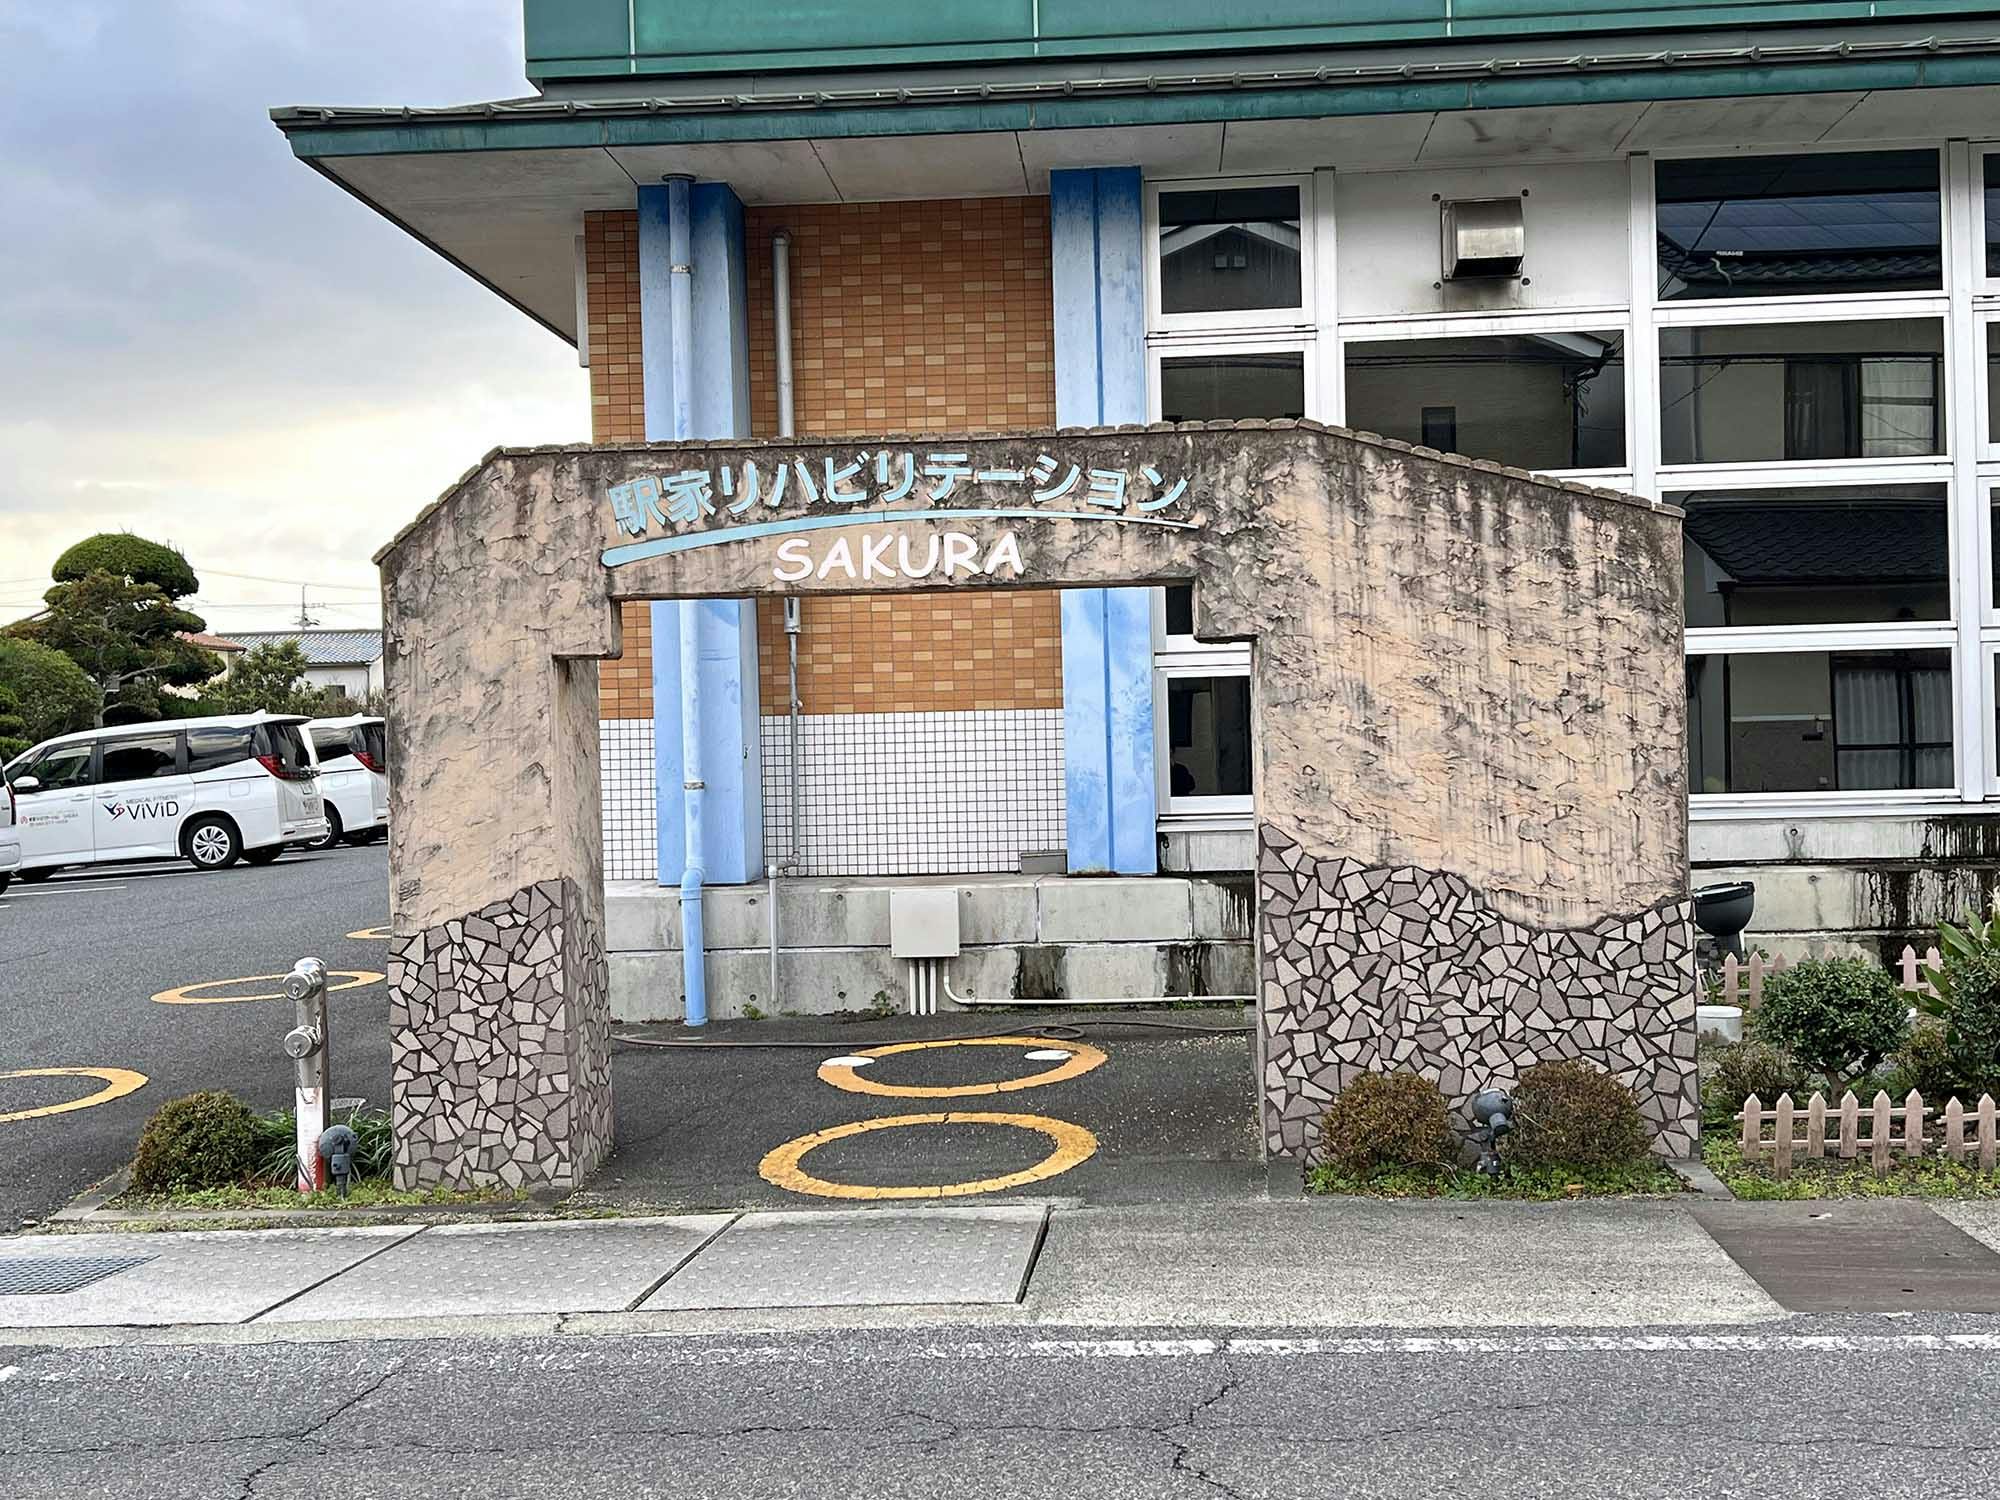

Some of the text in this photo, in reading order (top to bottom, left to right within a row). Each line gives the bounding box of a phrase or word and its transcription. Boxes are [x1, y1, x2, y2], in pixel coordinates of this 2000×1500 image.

[606, 452, 1188, 534] 駅家リハビリテーション
[773, 531, 1025, 582] SAKURA
